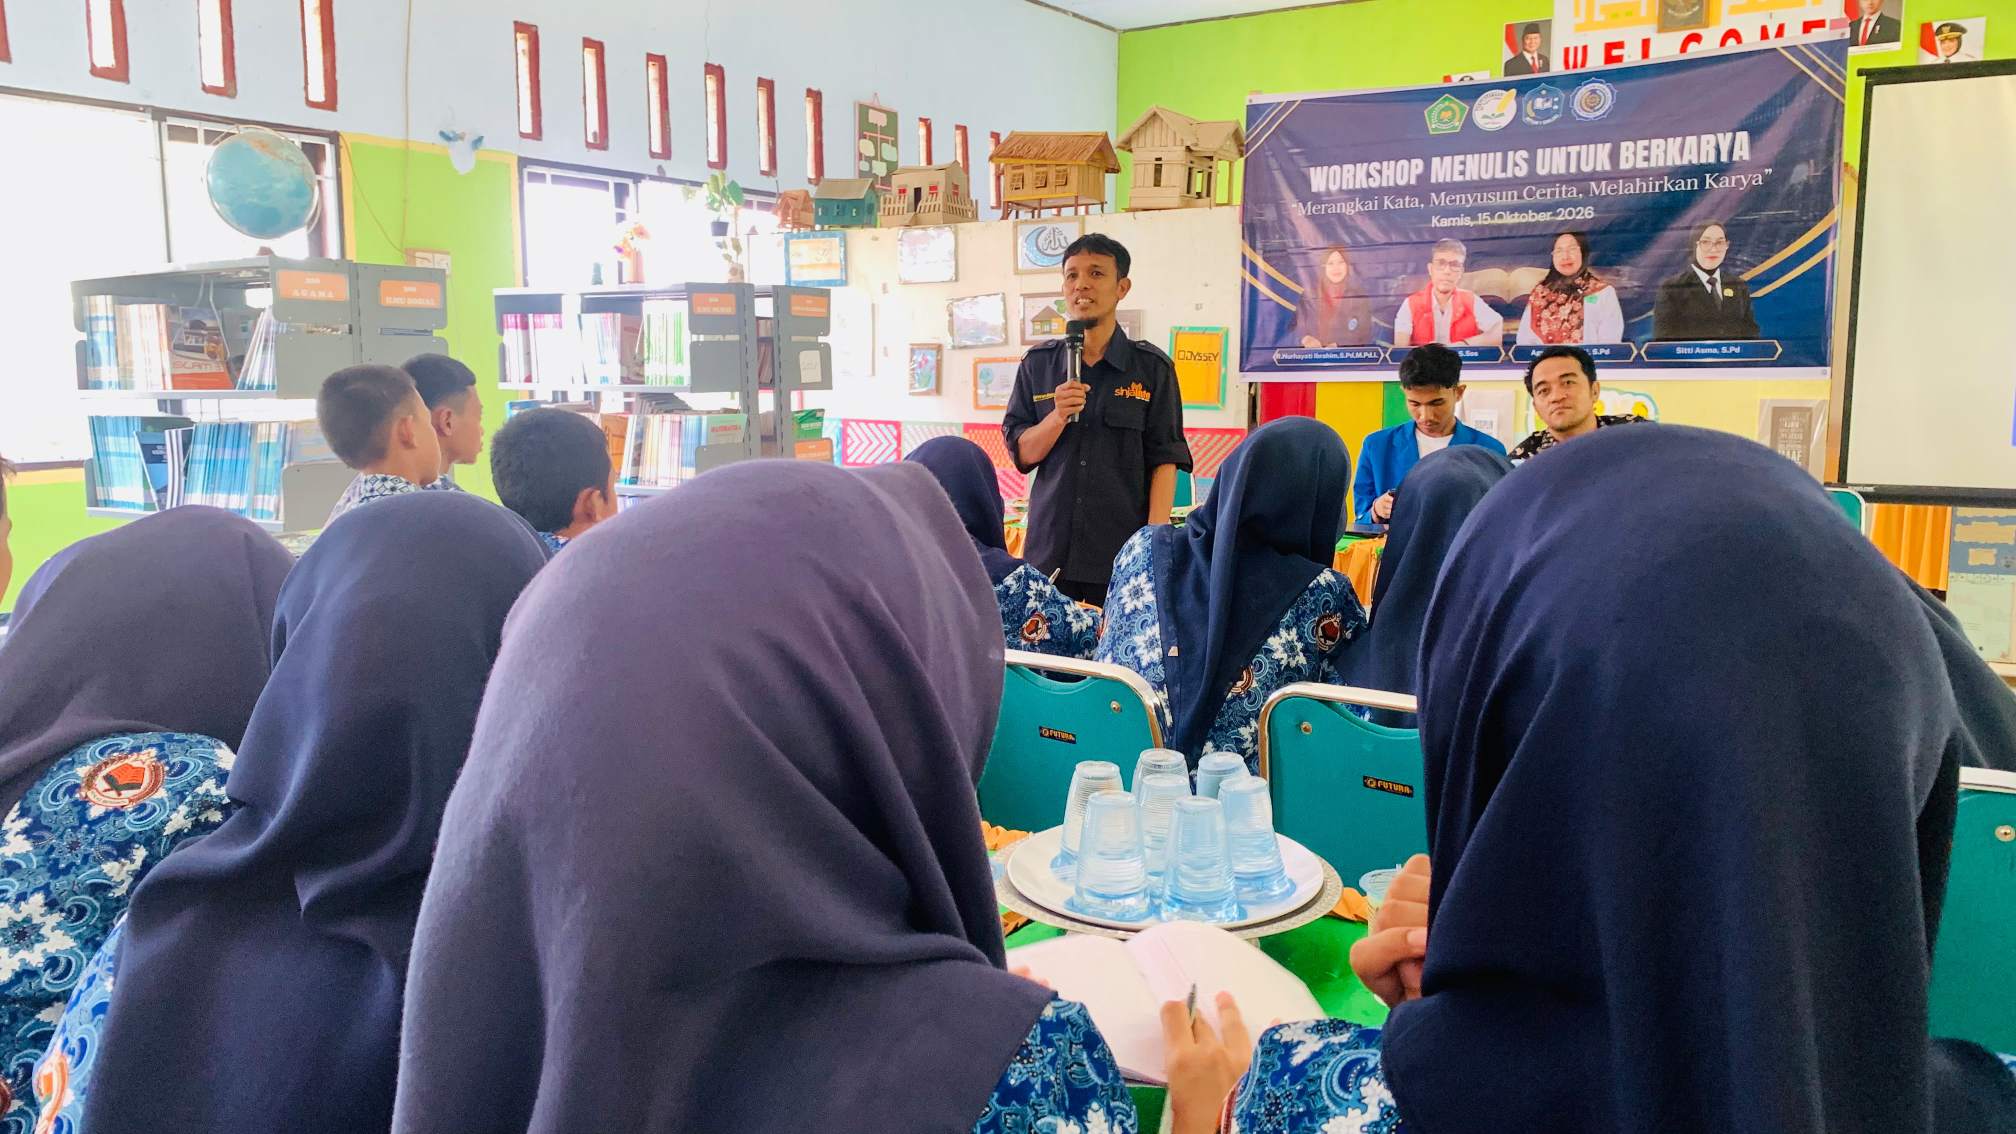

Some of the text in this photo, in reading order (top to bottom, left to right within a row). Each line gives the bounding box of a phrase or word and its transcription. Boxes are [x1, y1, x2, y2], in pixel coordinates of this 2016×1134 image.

[1309, 130, 1750, 193] WORKSHOP MENULIS UNTUK BERKARYA
[1383, 194, 1425, 211] Kata,
[1430, 189, 1518, 209] Menyusun
[1523, 184, 1583, 201] Cerita,
[1590, 176, 1698, 198] Melahirkan
[1431, 206, 1594, 229] Kamis, 15 Oktober 2026
[1177, 350, 1219, 361] ODYSSEY
[1050, 729, 1074, 741] FUTURA
[1378, 780, 1410, 794] FUTURA
